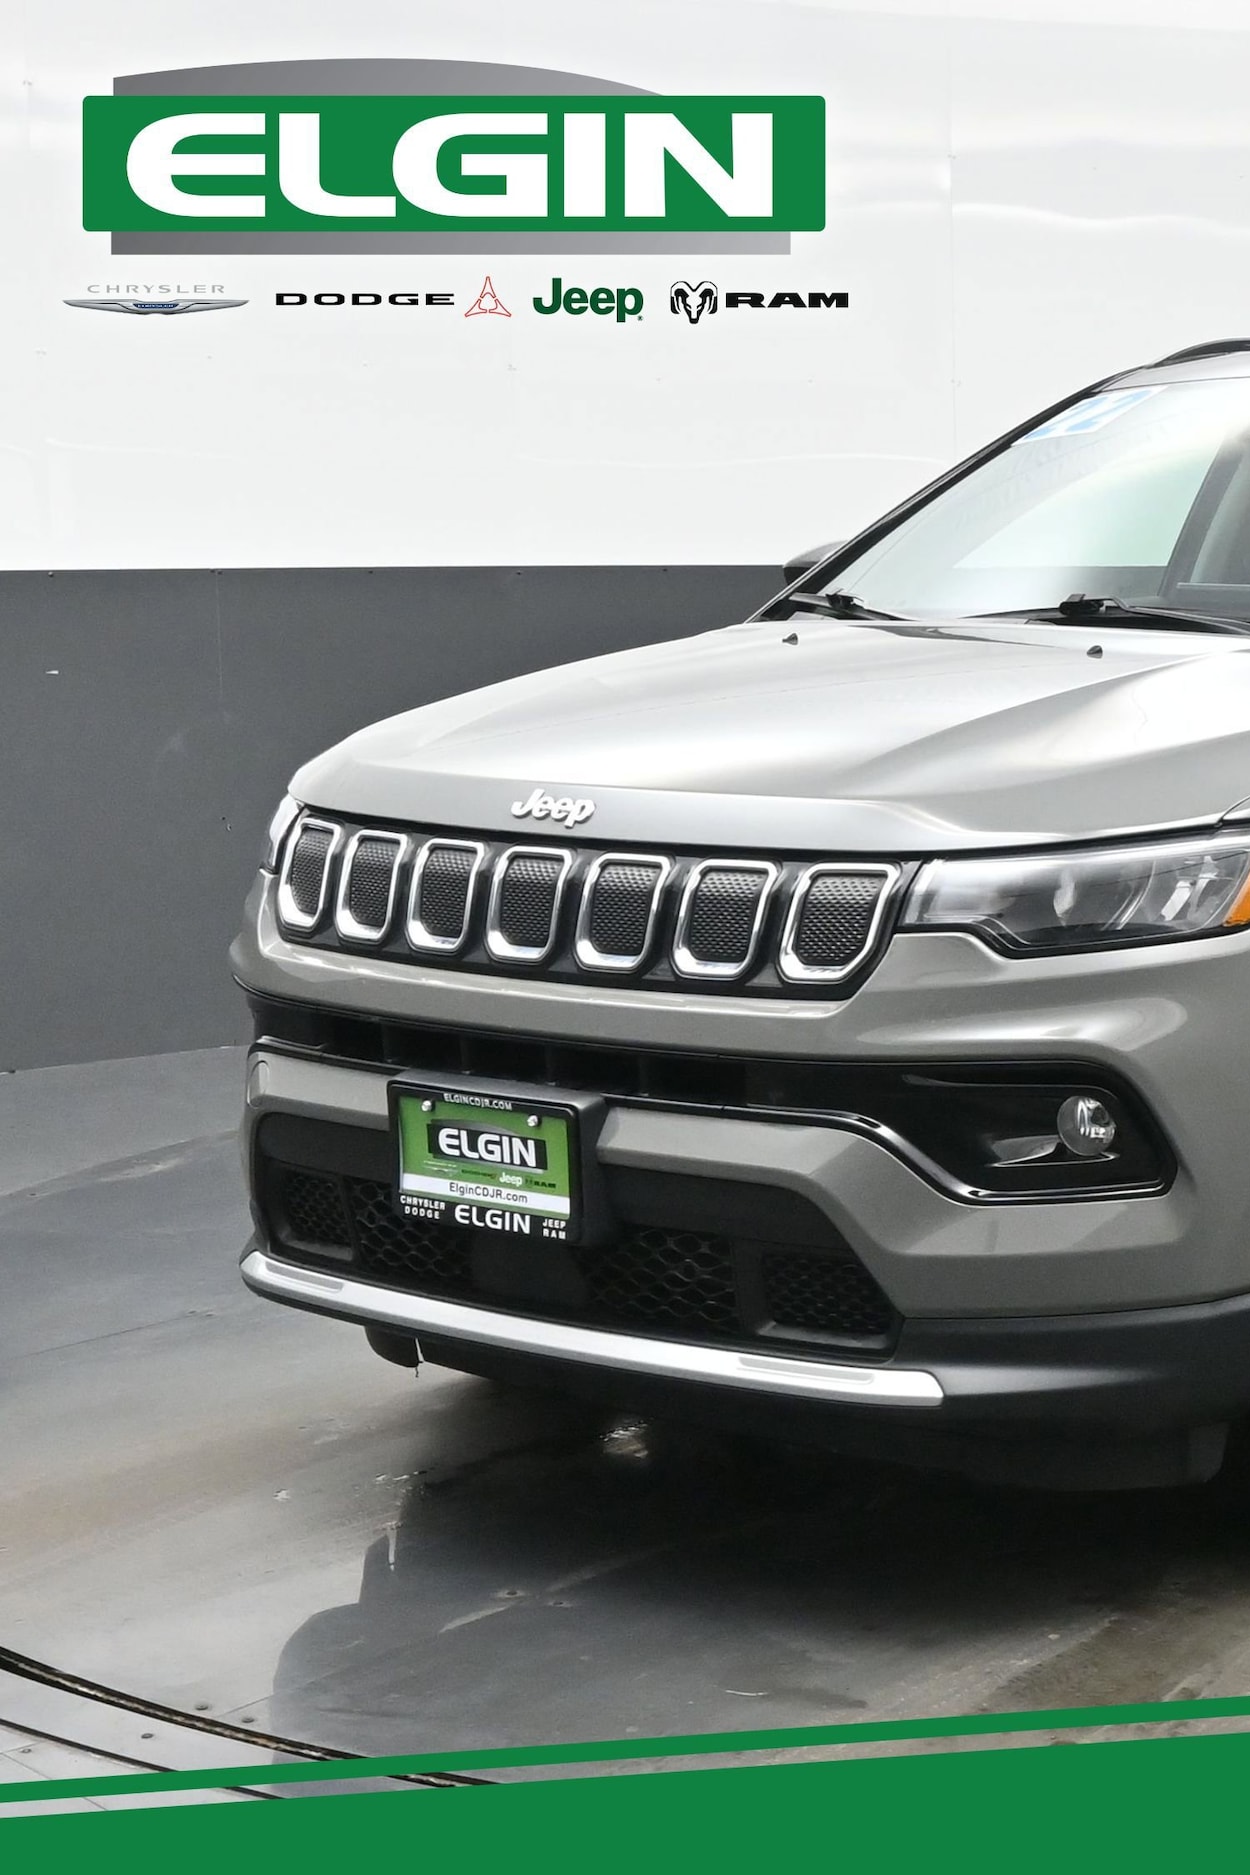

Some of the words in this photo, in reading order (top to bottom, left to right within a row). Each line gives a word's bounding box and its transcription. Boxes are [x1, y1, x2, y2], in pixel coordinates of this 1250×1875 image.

[510, 788, 596, 829] Jeep
[443, 1092, 513, 1112] ELGINCDJR.COM
[438, 1127, 537, 1168] ELGIN
[499, 1171, 523, 1187] Jeep
[448, 1181, 528, 1204] ElginCDJR.com
[400, 1194, 446, 1211] CHRYSLER
[404, 1205, 440, 1220] DODGE
[454, 1204, 531, 1235] ELGIN
[542, 1217, 567, 1229] JEEP
[542, 1227, 567, 1240] RAM
